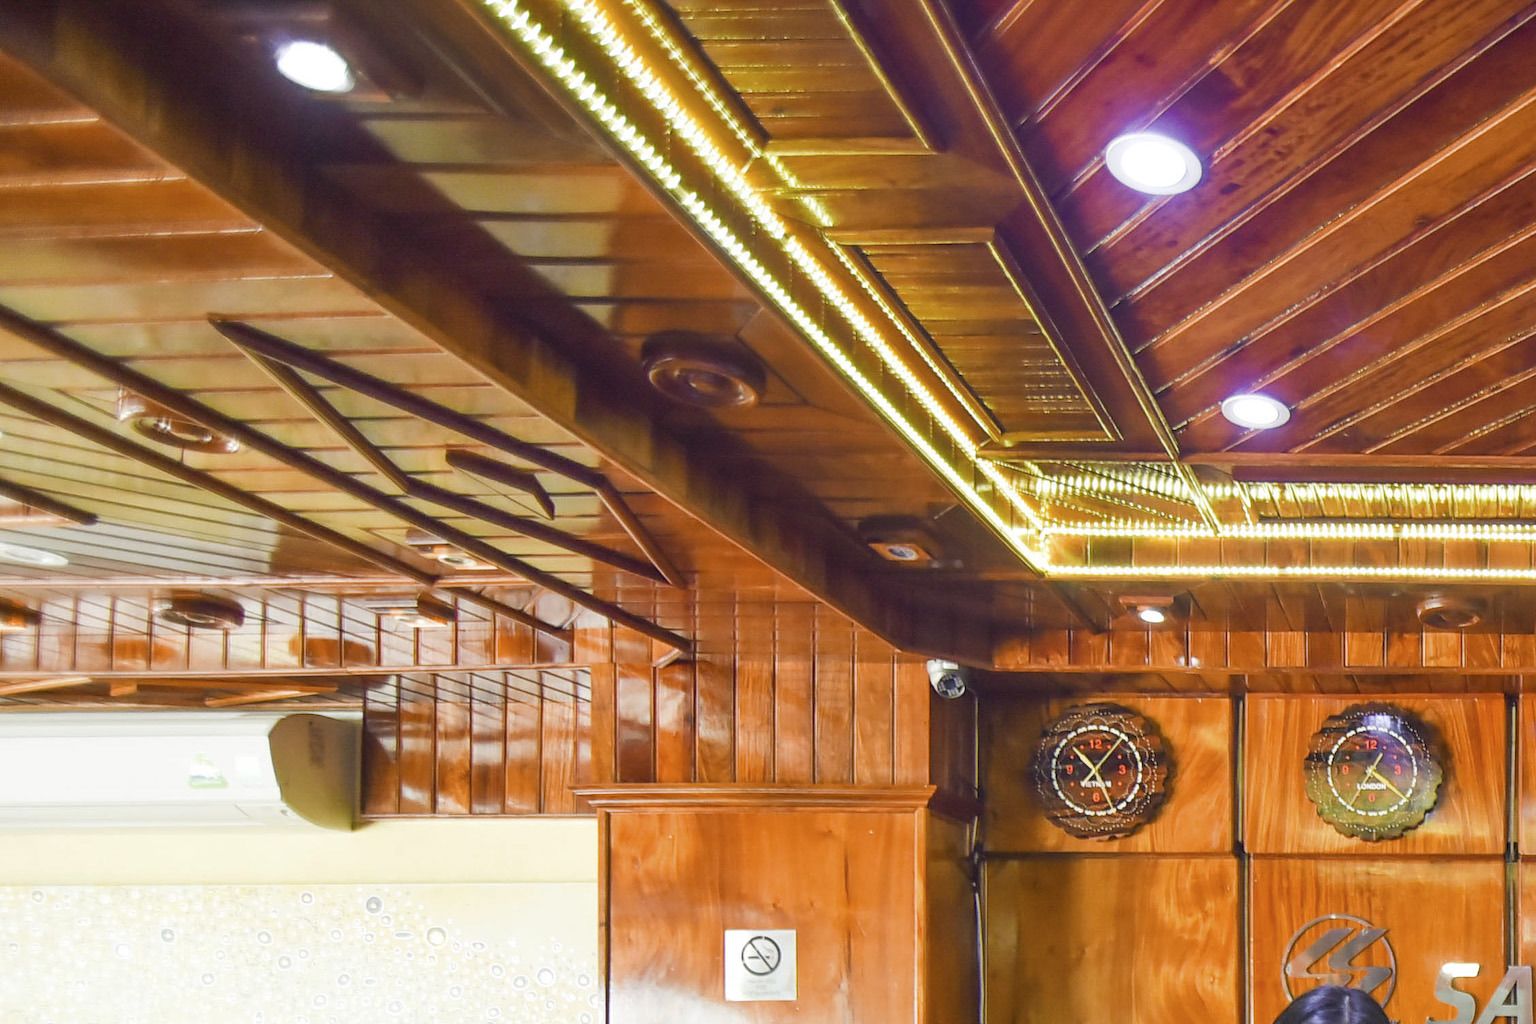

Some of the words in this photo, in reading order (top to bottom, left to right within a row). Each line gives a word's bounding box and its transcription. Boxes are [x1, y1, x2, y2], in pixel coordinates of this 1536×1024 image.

[1089, 740, 1102, 749] 12
[1365, 740, 1377, 750] 12
[1065, 765, 1073, 775] 9
[1118, 764, 1127, 775] 3
[1394, 764, 1402, 775] 3
[1080, 780, 1112, 788] VIETNM
[1356, 782, 1387, 791] LONDON
[1092, 792, 1100, 803] 6
